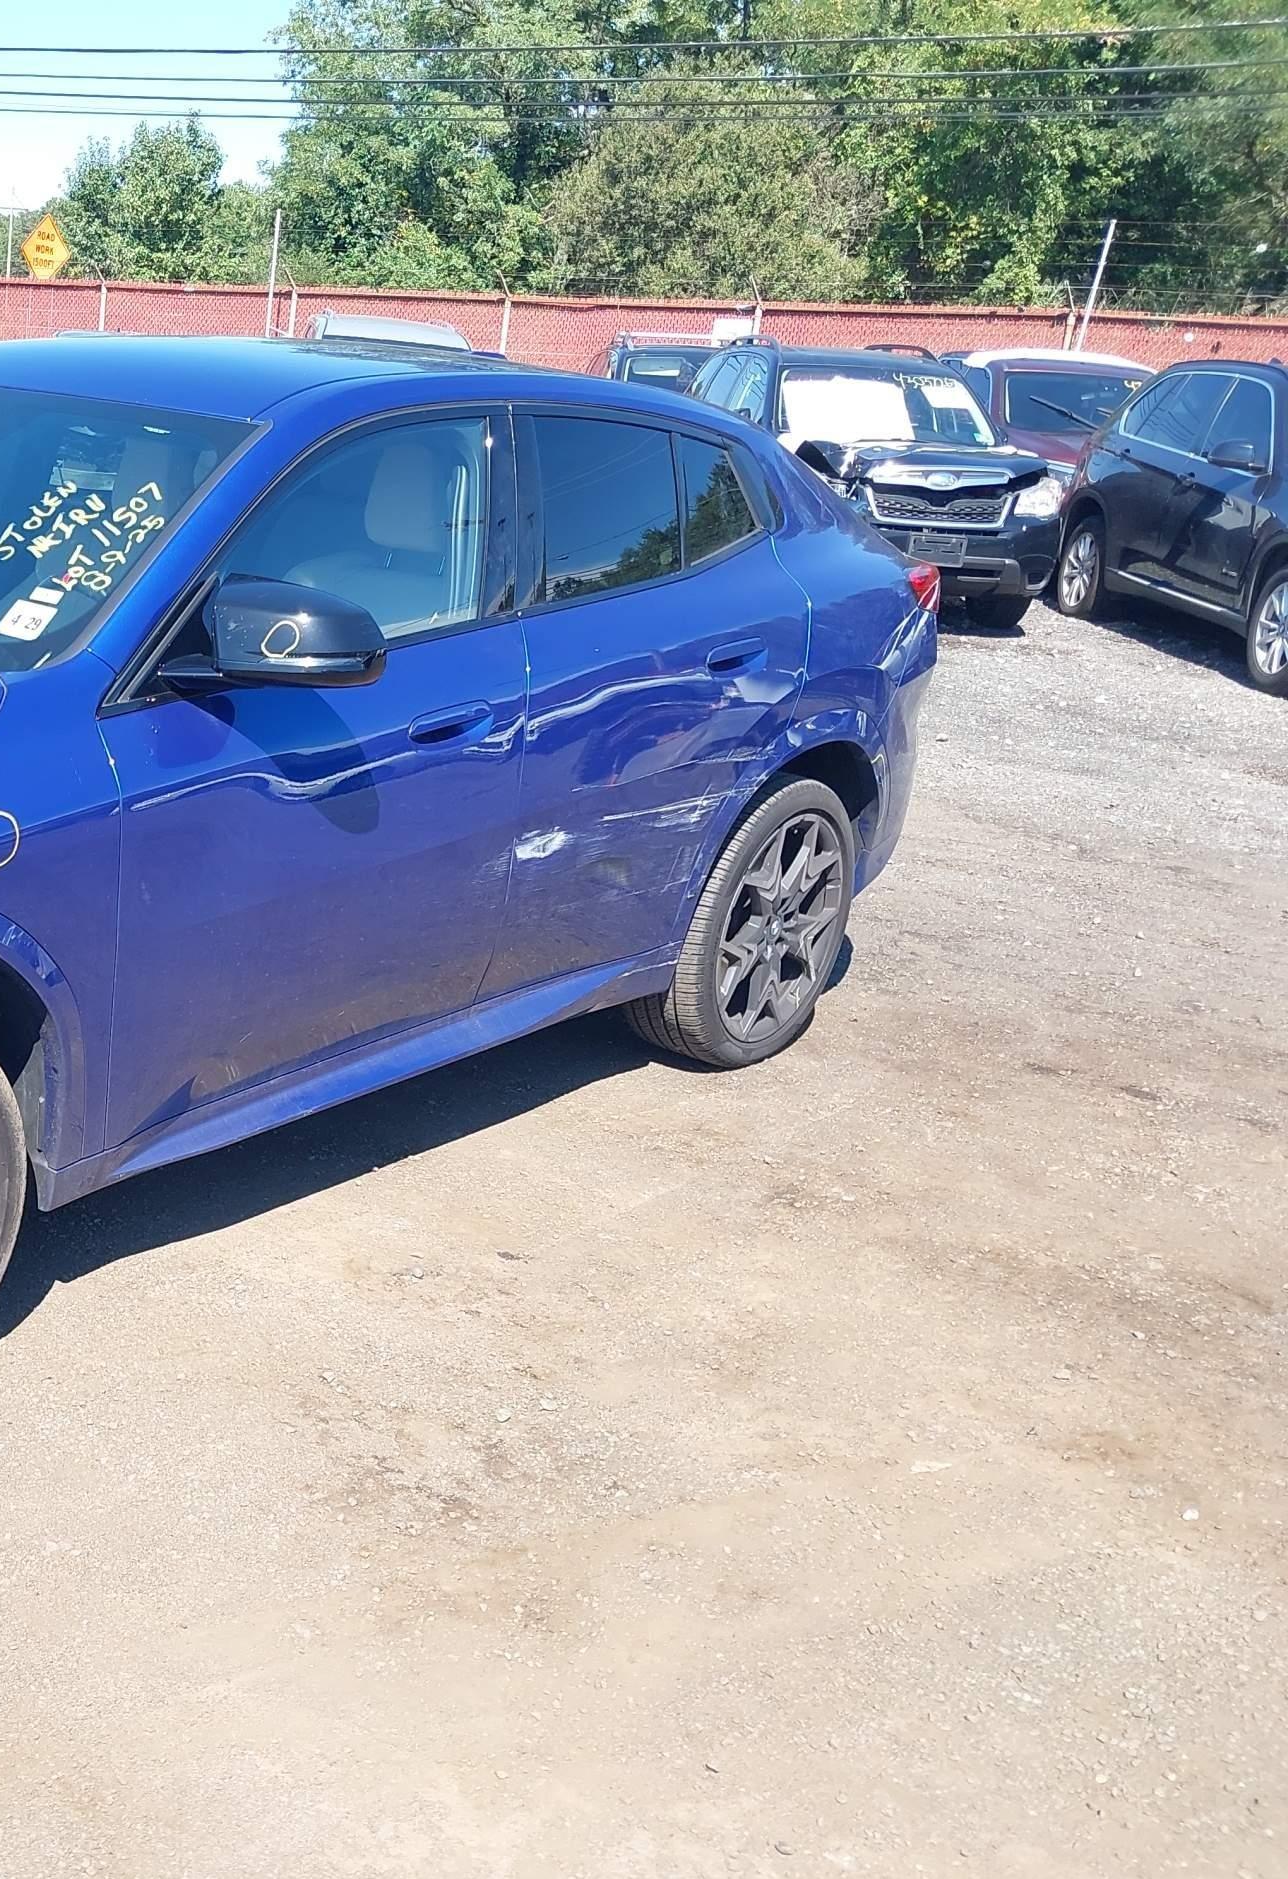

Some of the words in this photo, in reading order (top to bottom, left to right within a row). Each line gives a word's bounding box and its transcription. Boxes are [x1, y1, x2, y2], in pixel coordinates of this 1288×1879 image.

[37, 231, 55, 242] ROAD
[36, 244, 54, 255] WORK
[24, 617, 42, 631] 29
